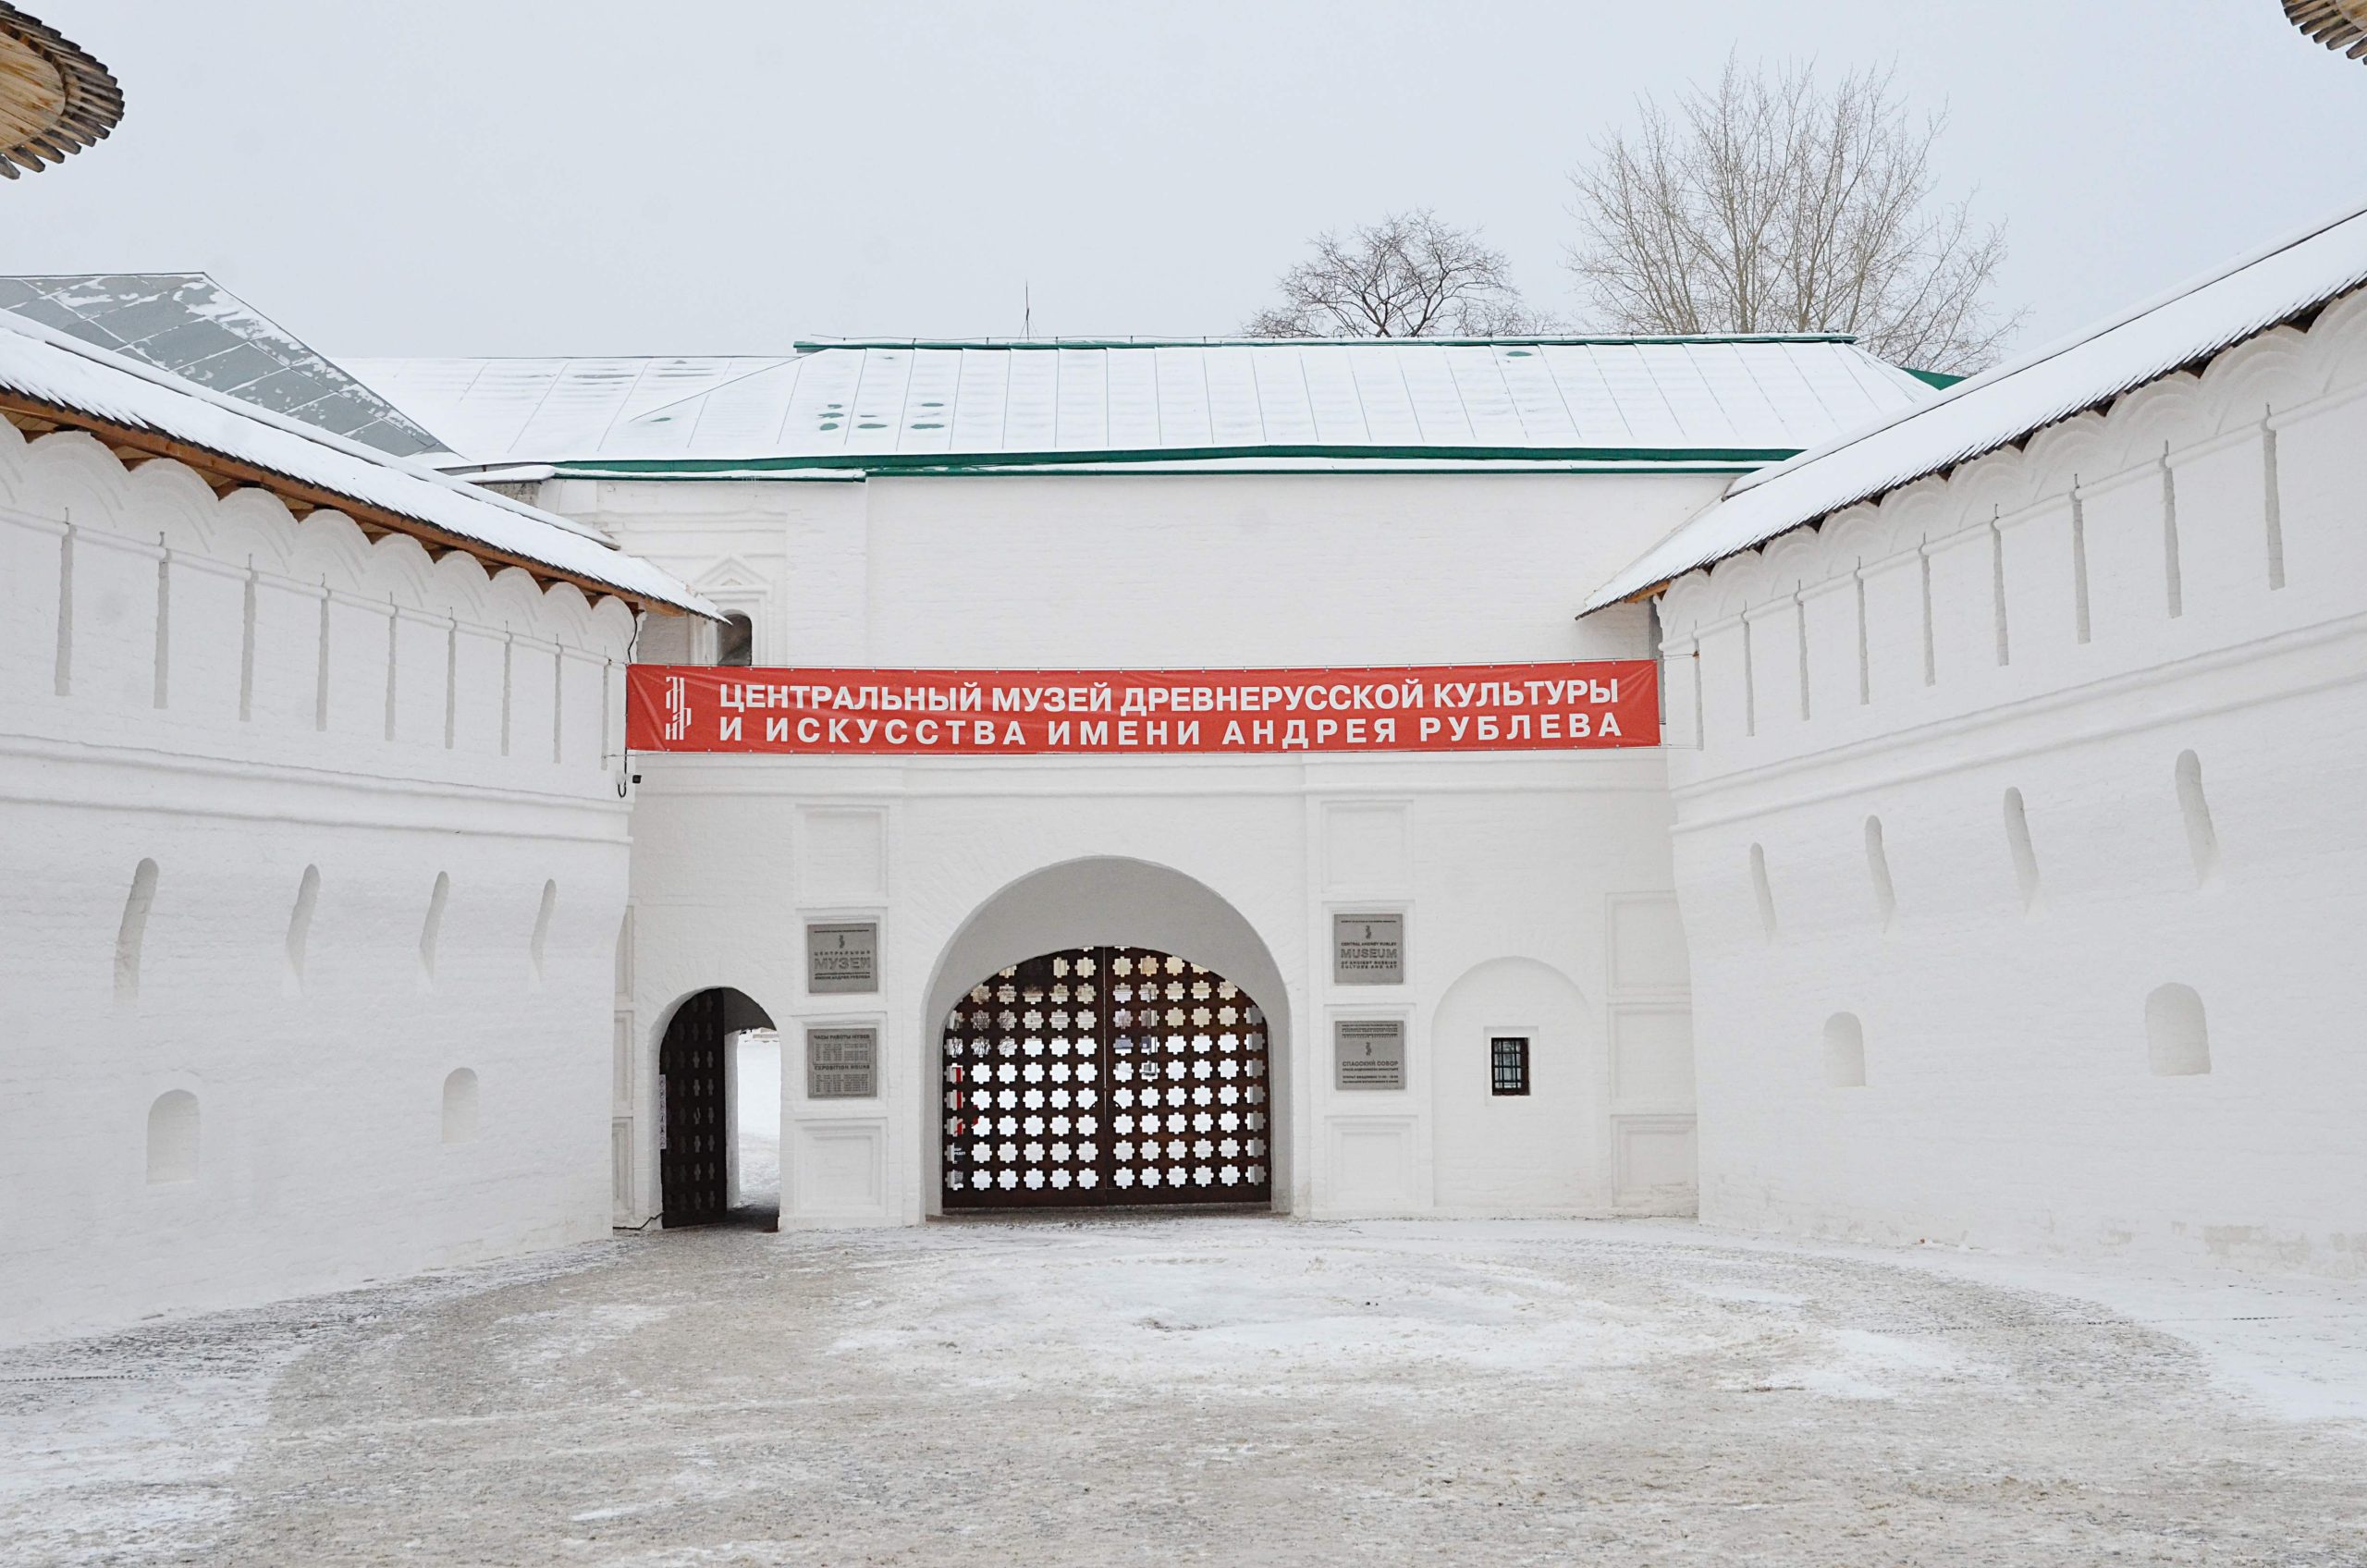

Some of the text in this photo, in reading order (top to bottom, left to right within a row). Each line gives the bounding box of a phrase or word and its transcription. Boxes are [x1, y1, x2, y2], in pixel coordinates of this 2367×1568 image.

[719, 681, 982, 713] ЦЕНТРАЛЬНЫЙ
[992, 681, 1112, 713] МУЗЕЙ
[1120, 678, 1424, 717] ДРЕВНЕРУССКОЙ
[1433, 678, 1619, 708] КУЛЬТУРЫ
[719, 712, 1622, 750] И ИСКУССТВА ИМЕНИ АНДРЕЯ РУБЛЕВА
[814, 956, 871, 970] МУЗЕЙ
[1341, 948, 1397, 959] MUSEUM
